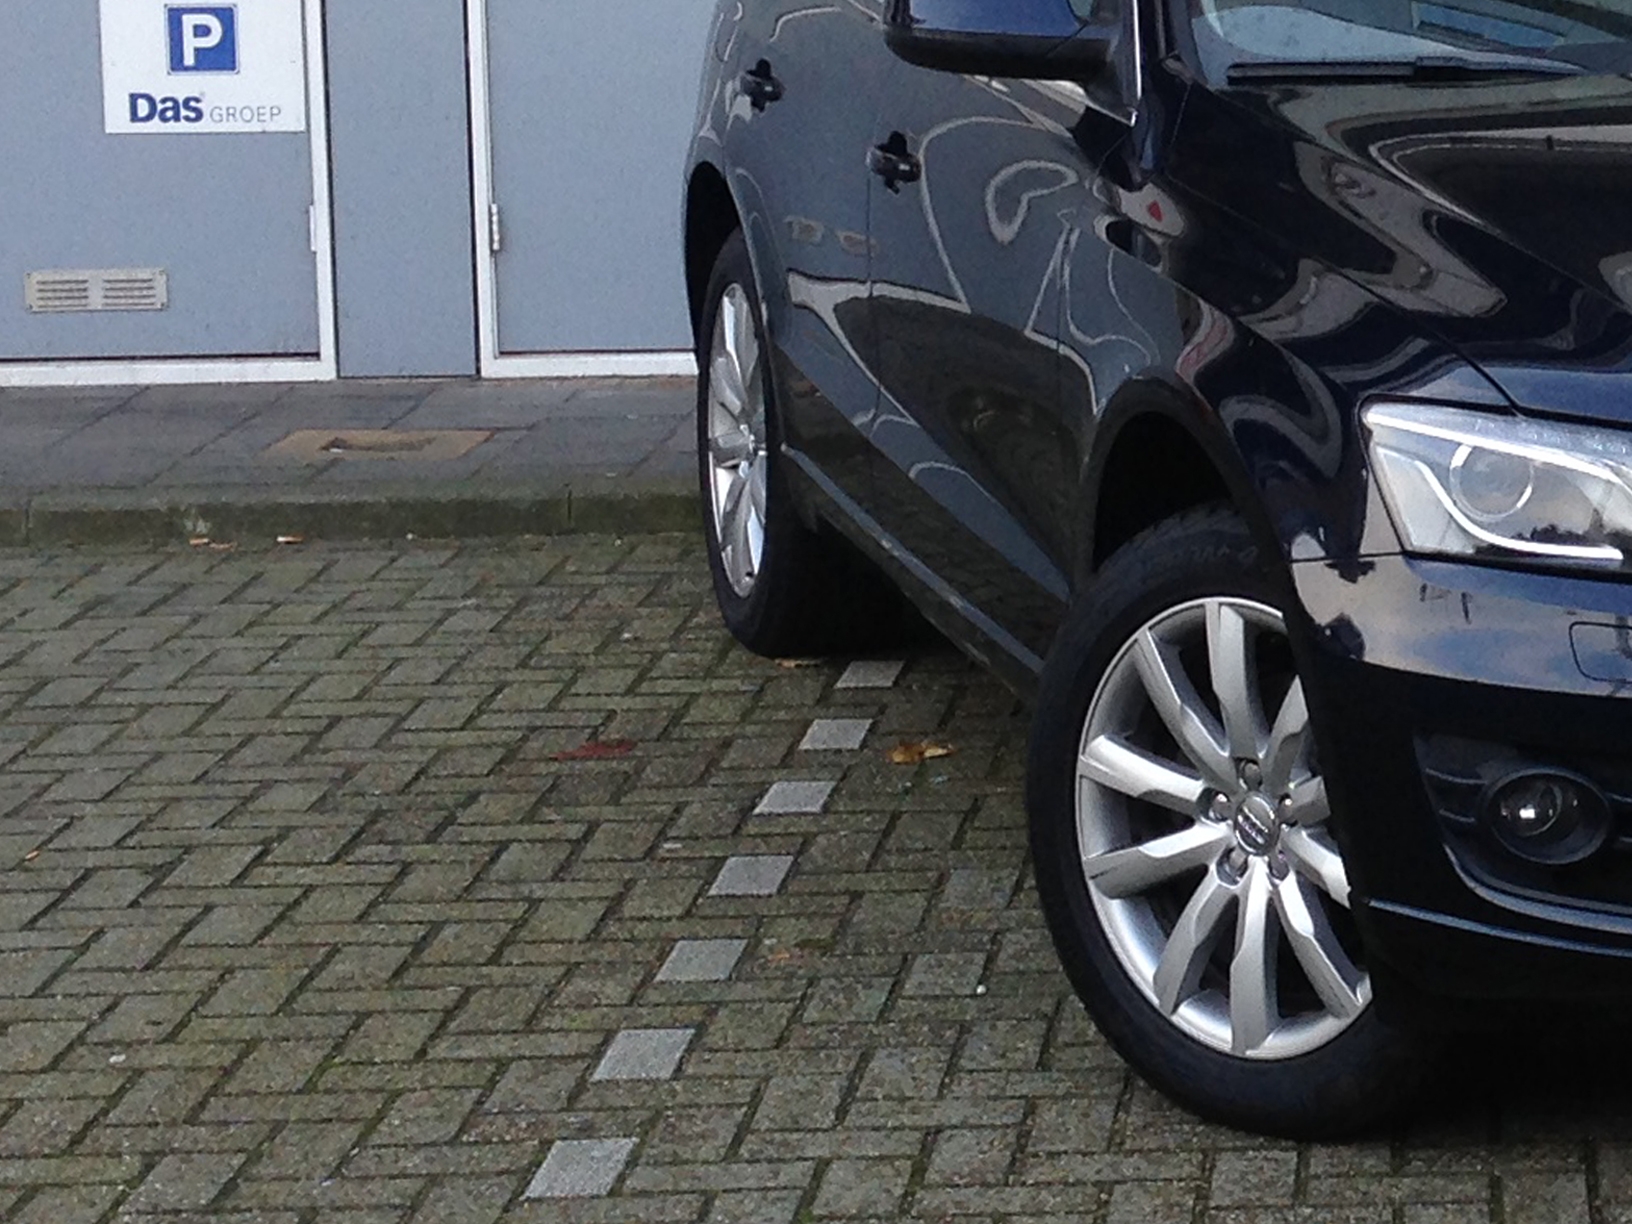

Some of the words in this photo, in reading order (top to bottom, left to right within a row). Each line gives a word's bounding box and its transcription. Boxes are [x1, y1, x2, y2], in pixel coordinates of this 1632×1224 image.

[182, 13, 223, 66] P
[128, 93, 204, 123] Das
[209, 106, 282, 123] GROEP
